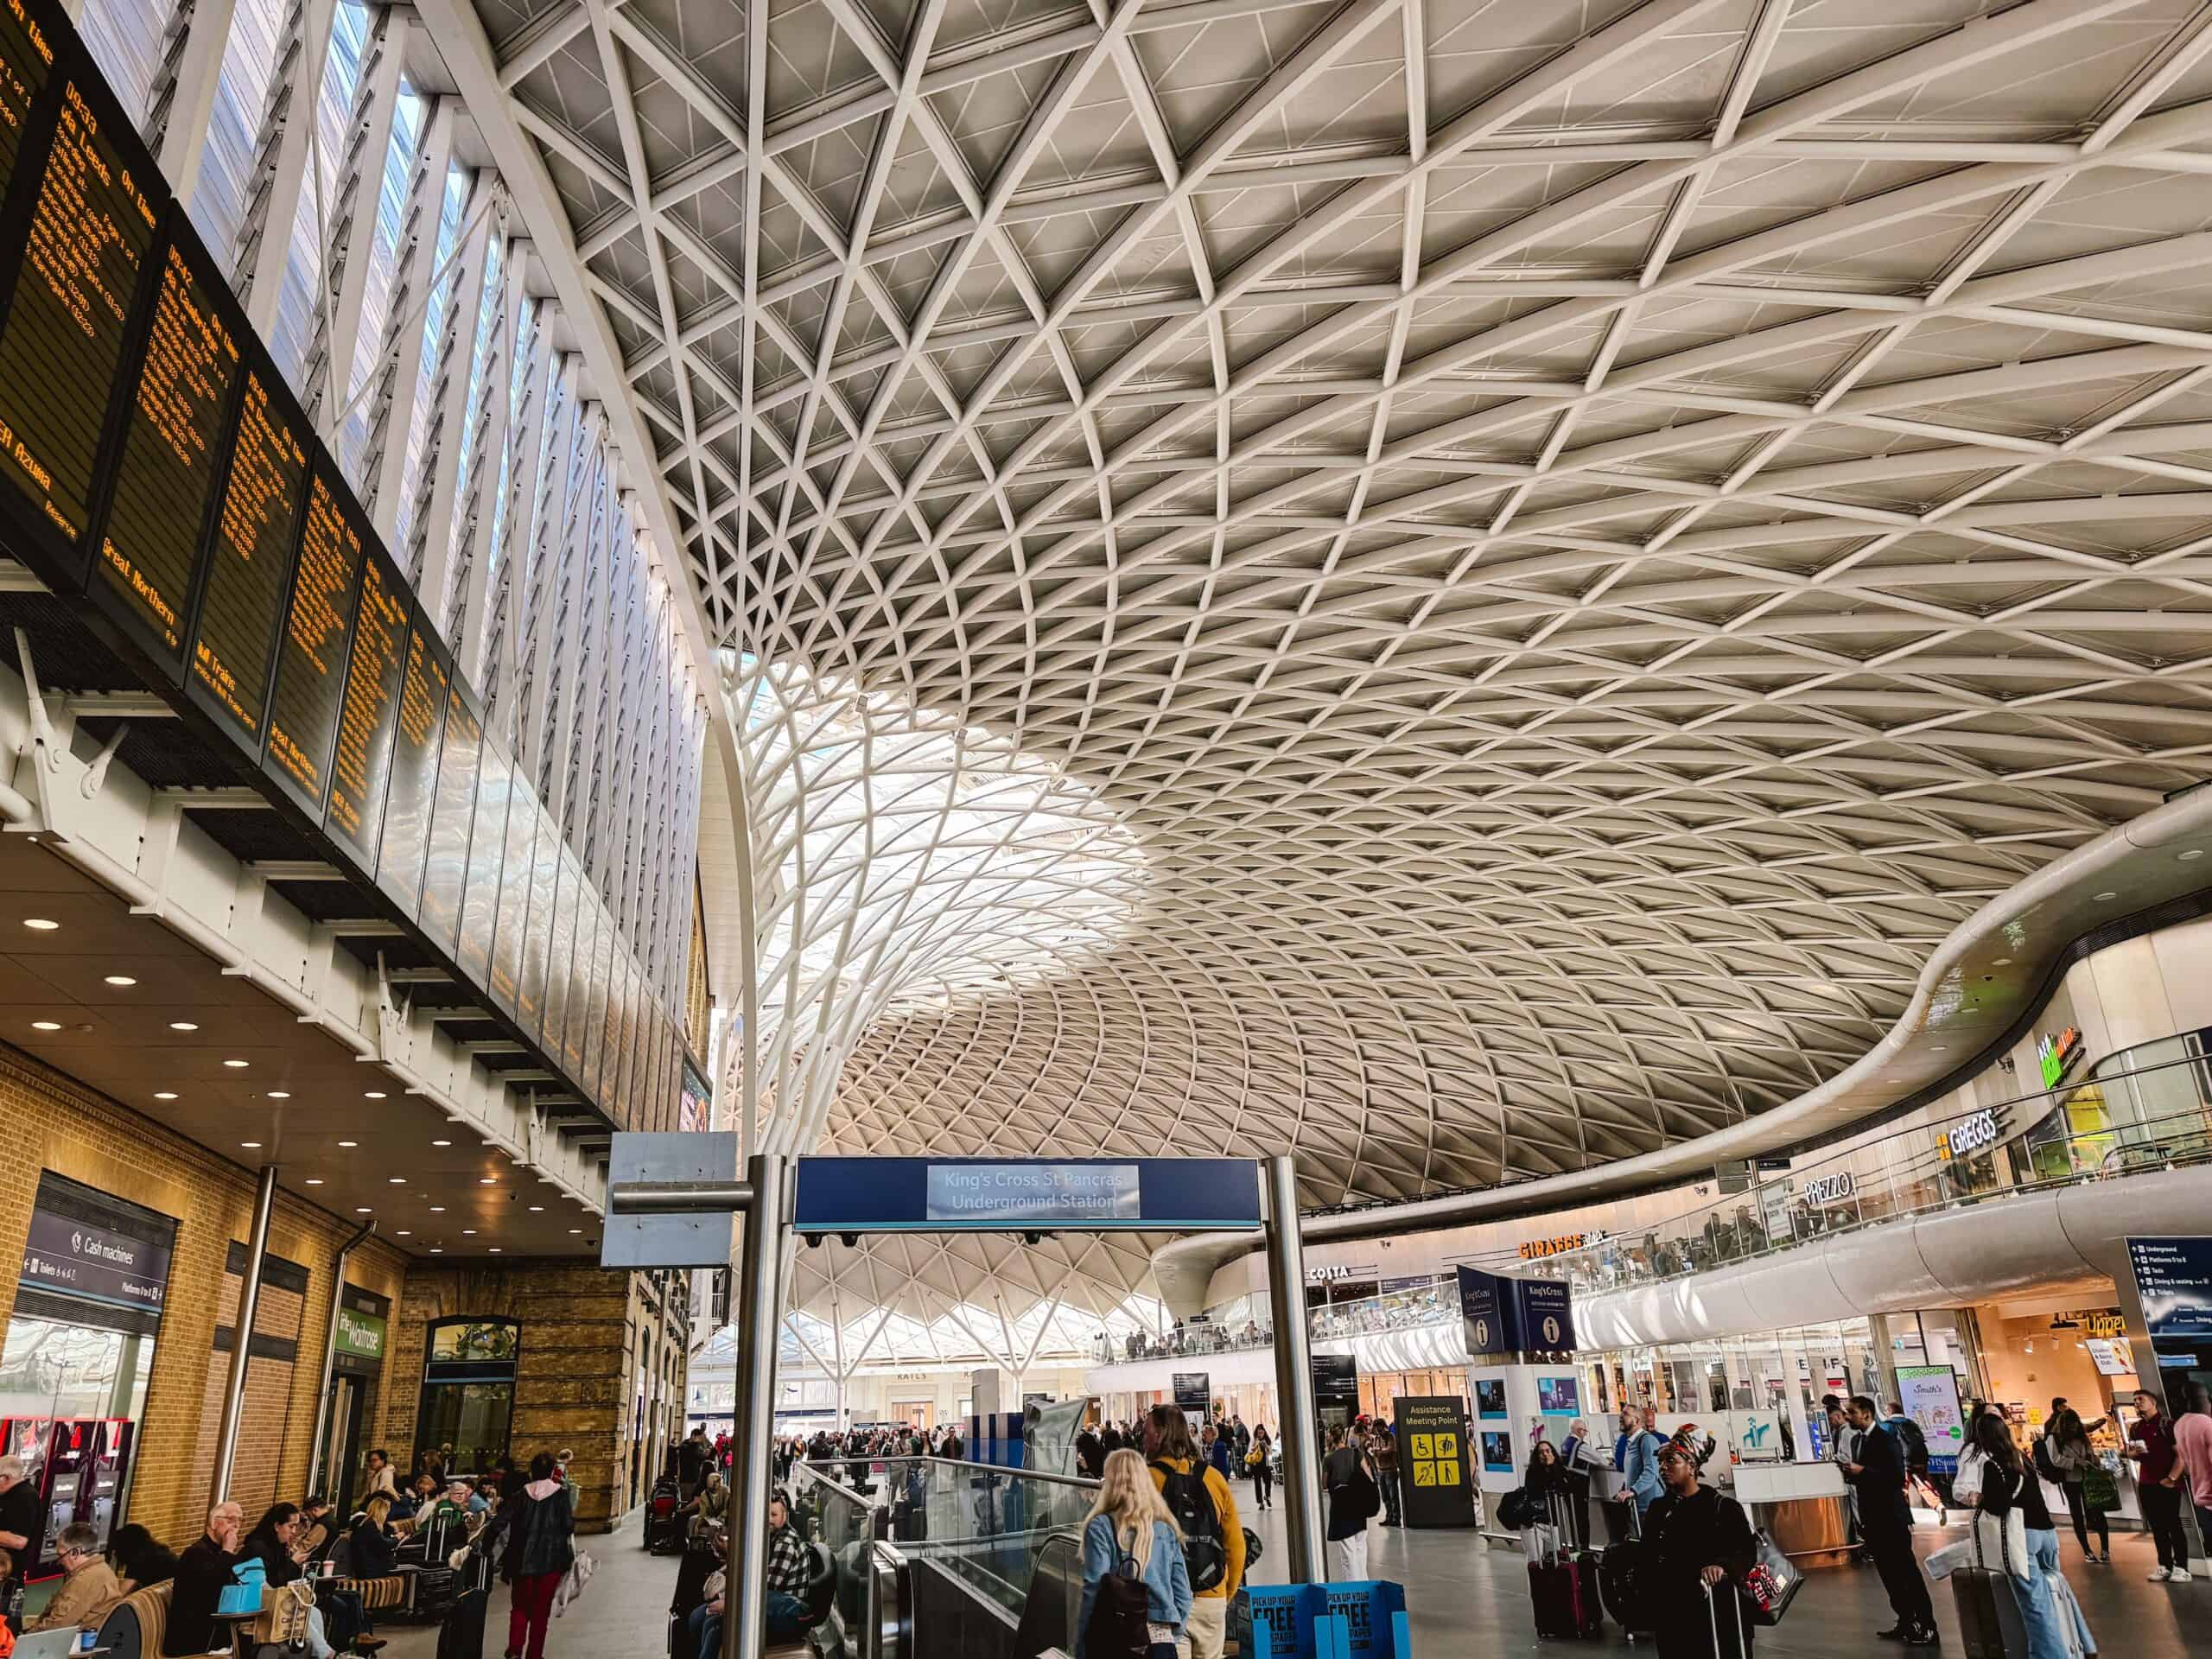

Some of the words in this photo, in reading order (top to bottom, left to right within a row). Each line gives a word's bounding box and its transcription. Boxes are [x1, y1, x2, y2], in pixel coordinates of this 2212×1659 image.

[29, 20, 54, 65] time
[67, 83, 97, 135] 09:33
[61, 107, 77, 135] via
[80, 132, 111, 186] Leeds
[122, 170, 135, 196] On
[137, 194, 156, 229] time
[212, 315, 222, 336] On
[283, 427, 292, 446] On
[15, 442, 52, 492] Azuma
[103, 537, 130, 578] Great
[132, 570, 175, 626] Northern
[212, 655, 236, 691] Trains
[1950, 1109, 1996, 1154] GREGGS
[944, 1173, 990, 1189] King's
[995, 1172, 1038, 1186] Cross
[1042, 1172, 1060, 1186] St
[1064, 1173, 1122, 1187] Pancras
[1804, 1173, 1849, 1205] PREZZO
[952, 1194, 1057, 1211] Underground
[1061, 1193, 1116, 1208] Station
[85, 1237, 102, 1257] Cash
[103, 1245, 134, 1265] machines
[1519, 1233, 1582, 1258] GIRAFFE
[1309, 1266, 1349, 1280] COSTA
[349, 1320, 378, 1351] Waitrose
[1914, 1383, 1942, 1394] Smith's
[1406, 1417, 1437, 1426] Meeting
[1277, 1595, 1295, 1605] YOUR
[1351, 1591, 1369, 1600] YOUR
